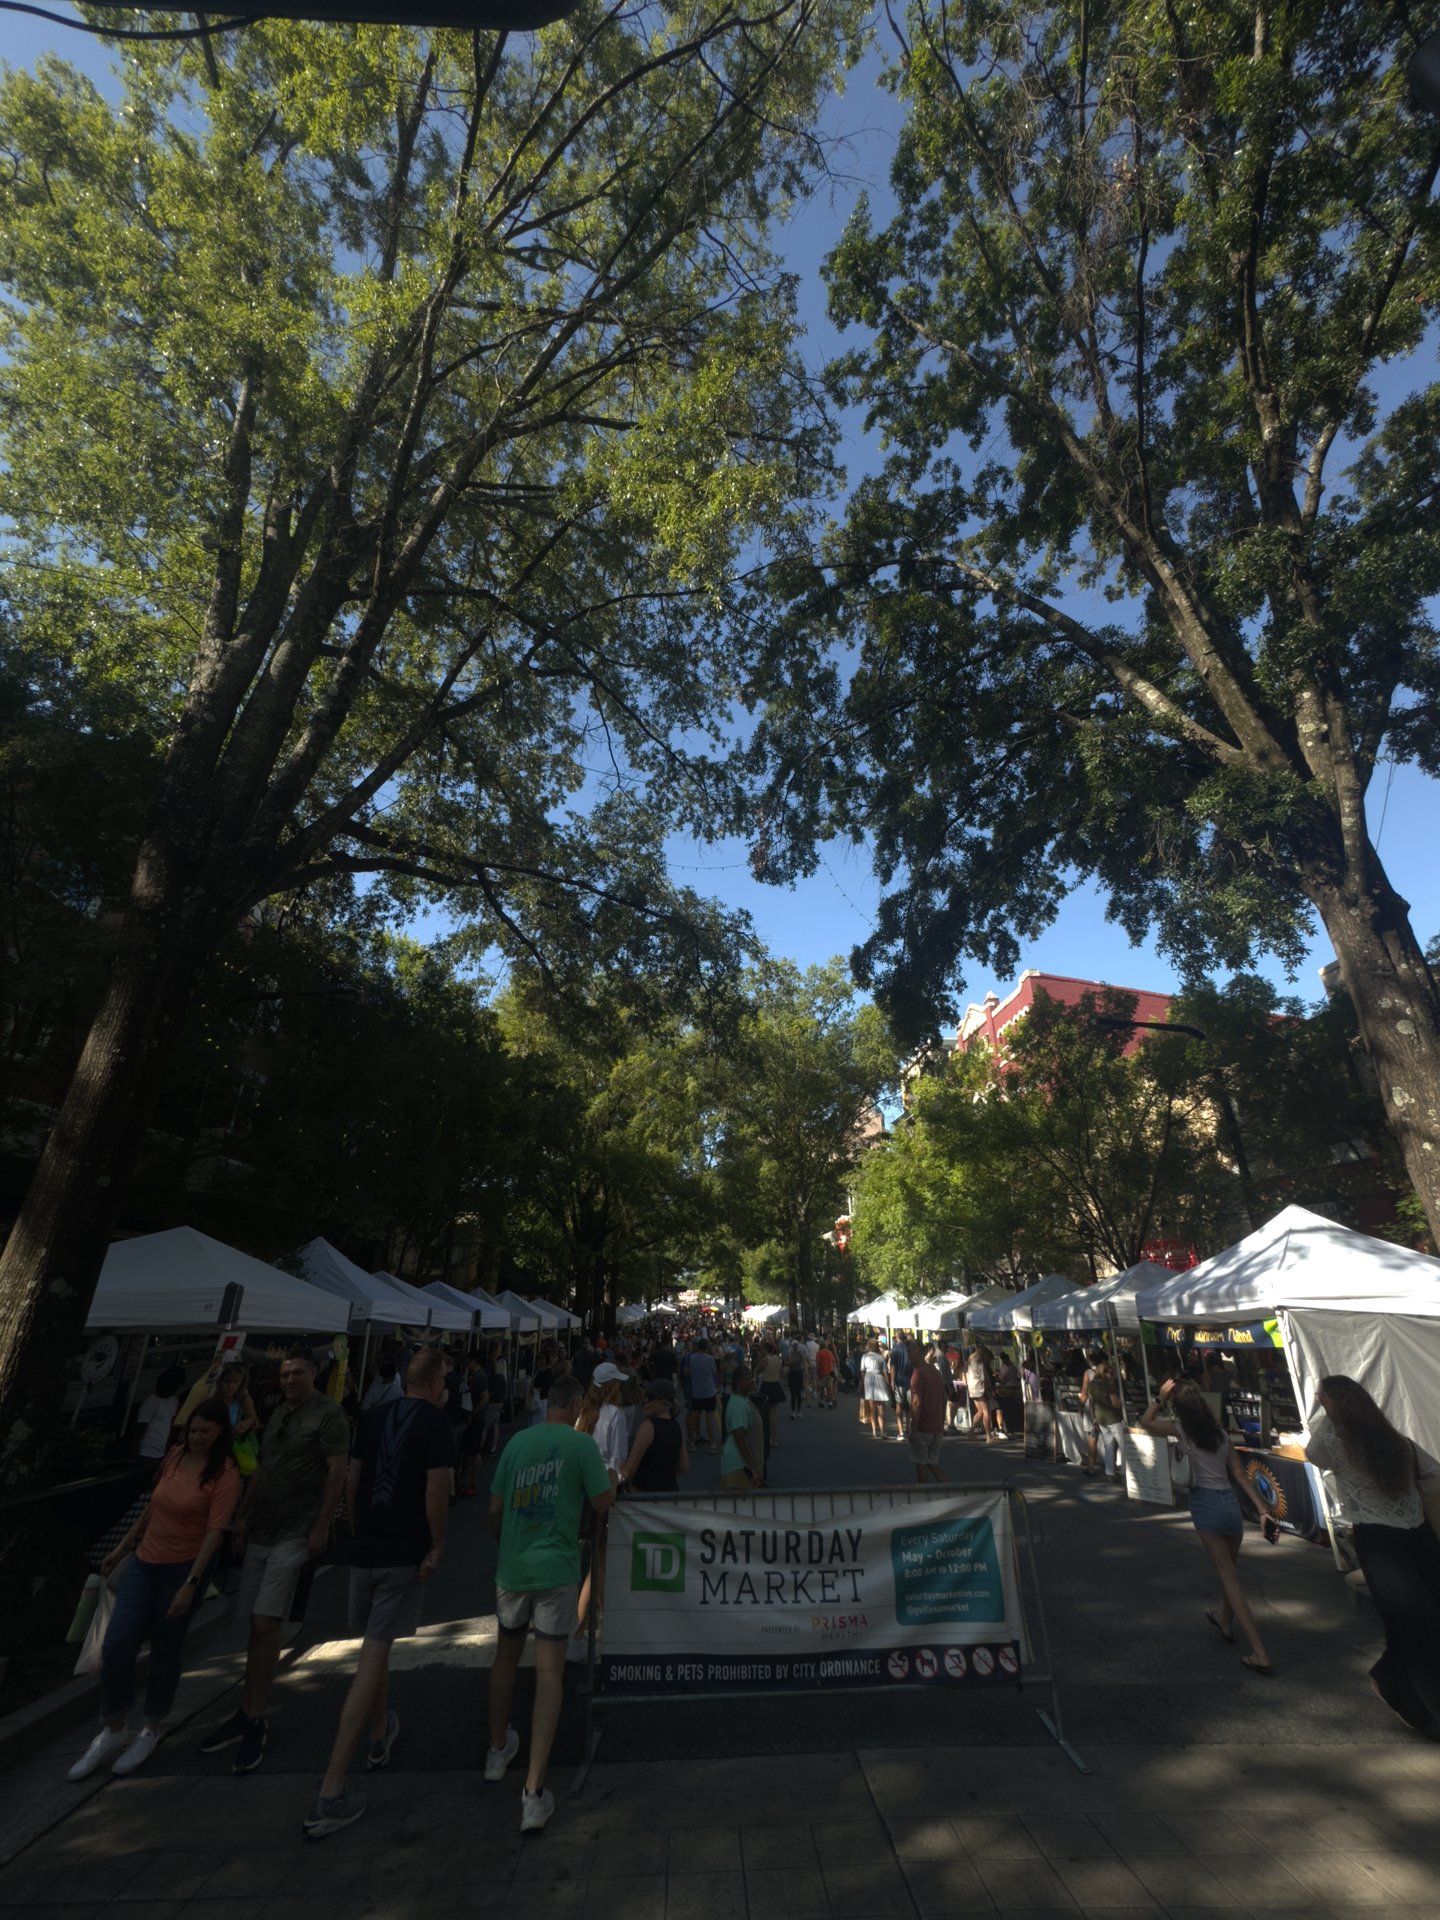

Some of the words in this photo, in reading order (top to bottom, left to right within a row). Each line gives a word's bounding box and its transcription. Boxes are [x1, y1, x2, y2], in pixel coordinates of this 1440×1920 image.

[516, 1459, 564, 1488] HOPPY
[542, 1484, 559, 1499] IPA
[700, 1528, 864, 1565] SATURDAY
[900, 1534, 928, 1547] Every
[931, 1529, 974, 1544] Saturday
[637, 1542, 680, 1580] TD
[902, 1551, 924, 1564] May
[935, 1547, 973, 1560] October
[924, 1567, 937, 1576] AM
[939, 1565, 947, 1574] to
[948, 1563, 971, 1574] 12:00
[973, 1562, 988, 1573] PM
[700, 1568, 865, 1606] MARKET
[811, 1615, 868, 1631] PRISMA
[822, 1631, 858, 1641] HEALTH
[610, 1663, 662, 1682] SMOKING
[665, 1664, 675, 1681] &
[676, 1663, 704, 1681] PETS
[707, 1663, 772, 1681] PROHIBITED
[775, 1662, 790, 1680] BY
[793, 1662, 816, 1679] CITY
[820, 1658, 881, 1678] ORDINANCE
